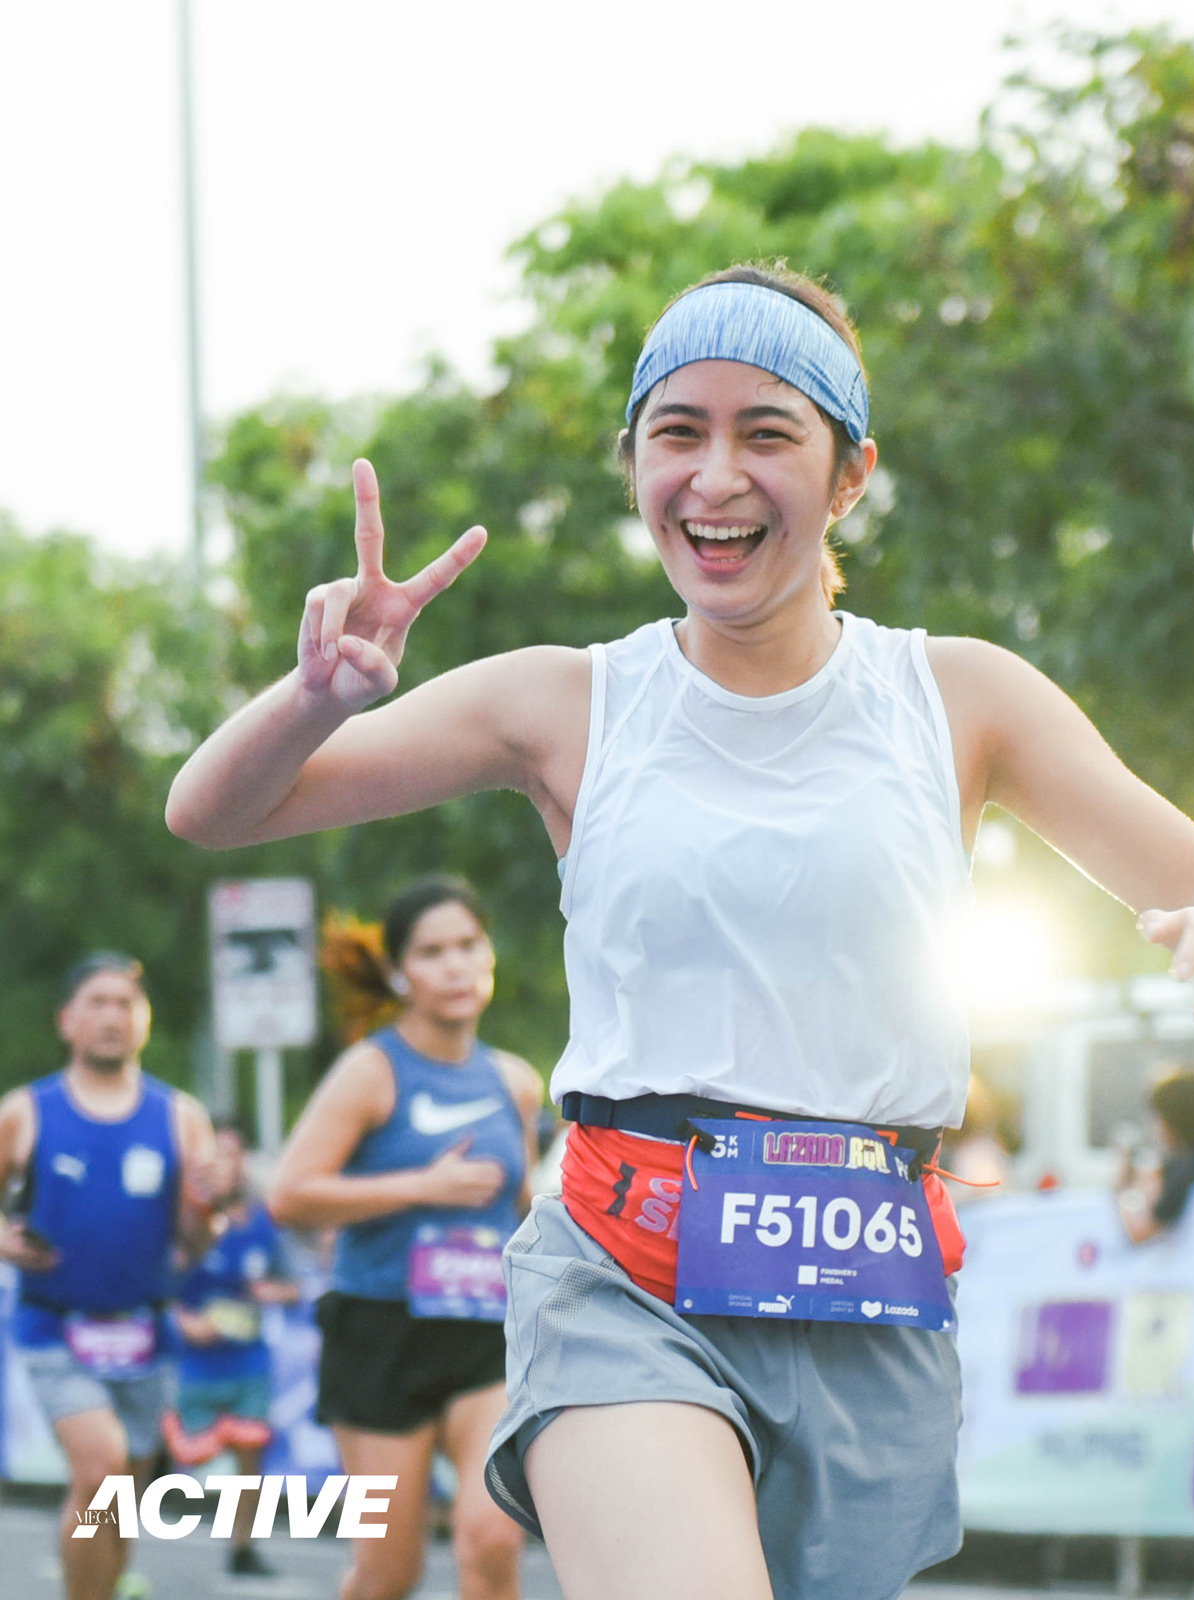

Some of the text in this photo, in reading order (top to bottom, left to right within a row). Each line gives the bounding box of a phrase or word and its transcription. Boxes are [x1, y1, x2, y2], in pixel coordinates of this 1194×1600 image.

[763, 1132, 845, 1166] LAZADA
[721, 1192, 923, 1258] F51065
[758, 1302, 787, 1314] PUMA
[885, 1304, 919, 1317] Lazada
